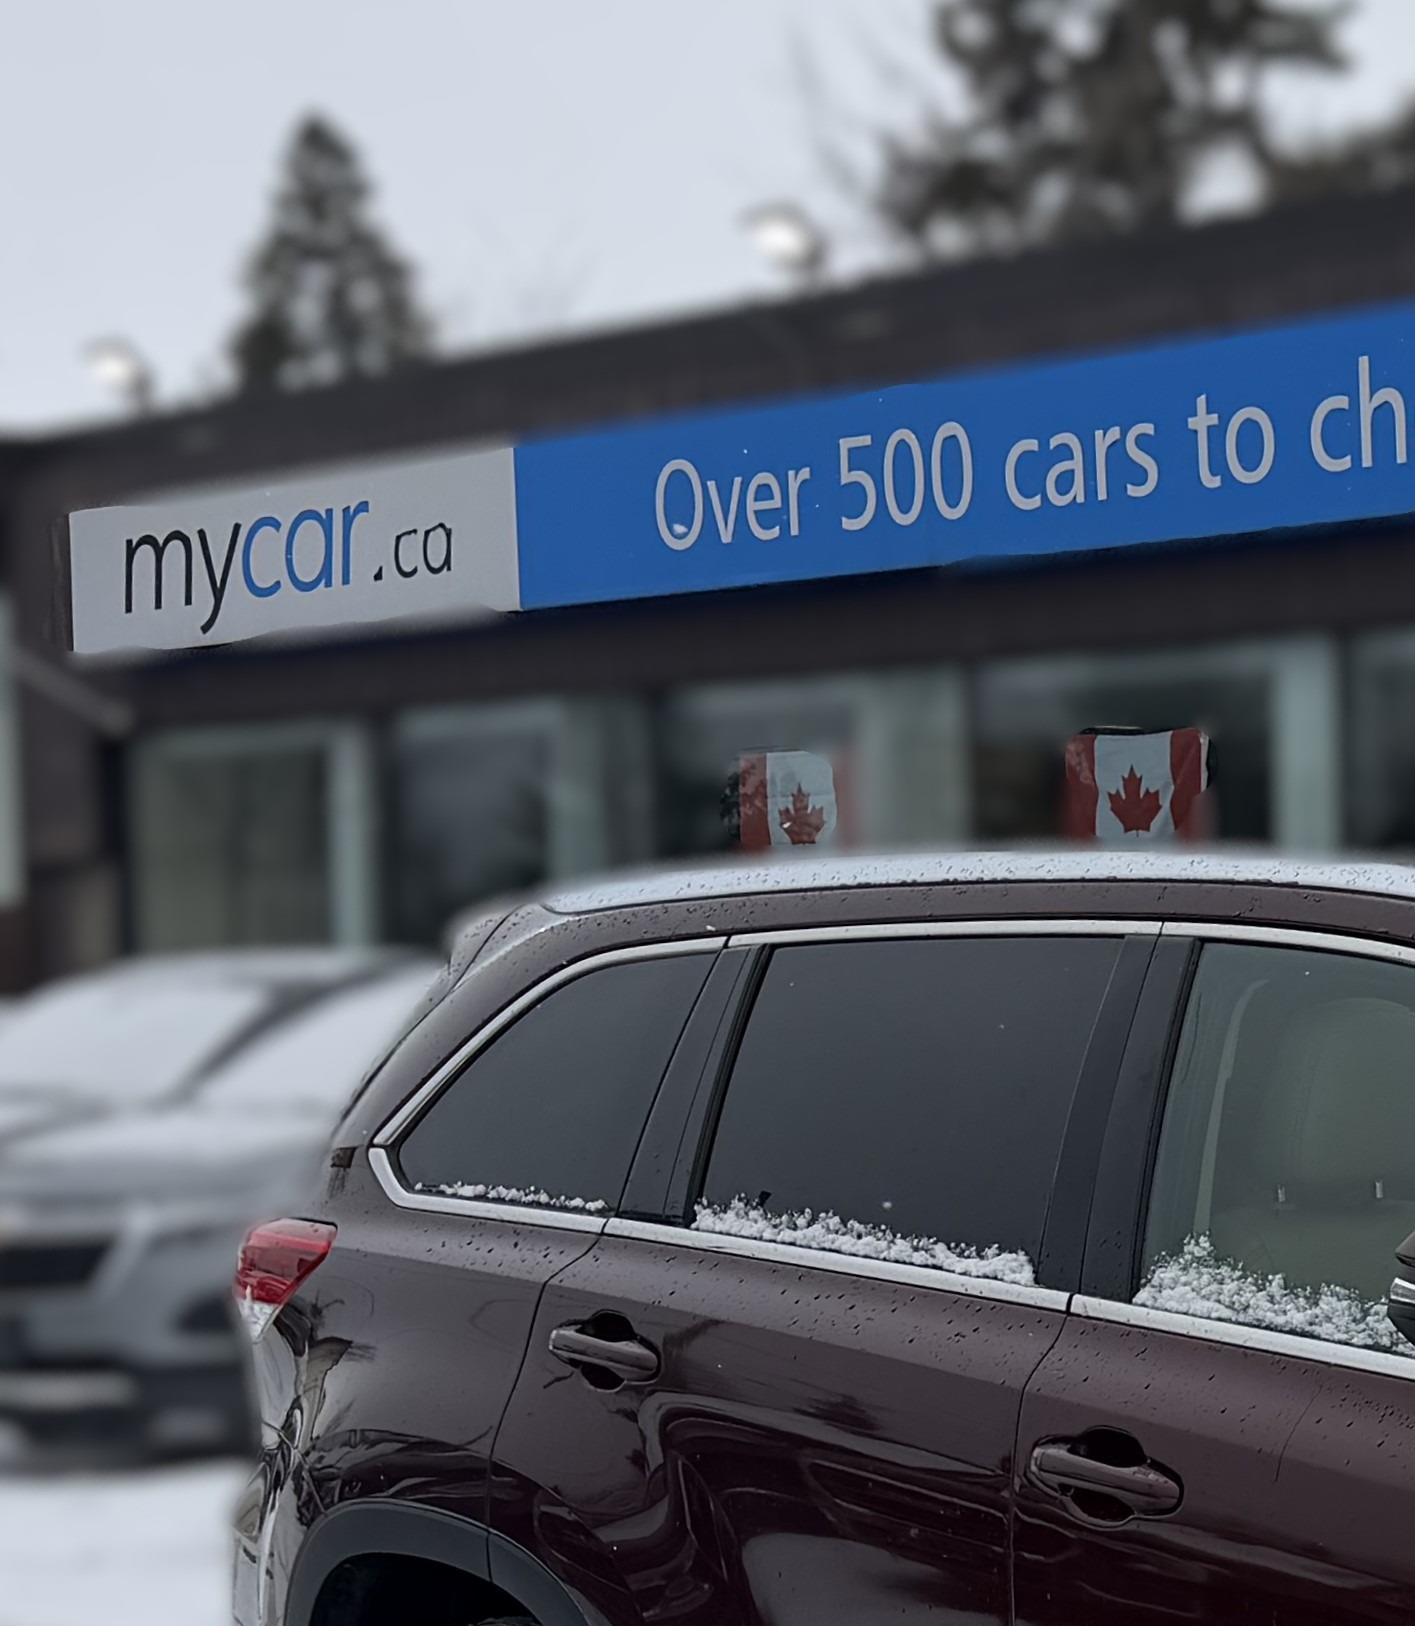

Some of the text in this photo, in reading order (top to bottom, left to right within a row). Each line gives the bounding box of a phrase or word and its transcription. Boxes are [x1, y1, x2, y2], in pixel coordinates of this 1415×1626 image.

[655, 458, 810, 551] Over
[837, 420, 974, 532] 500
[1004, 417, 1159, 511] cars
[1187, 393, 1276, 489] to
[124, 500, 453, 635] mycar.ca
